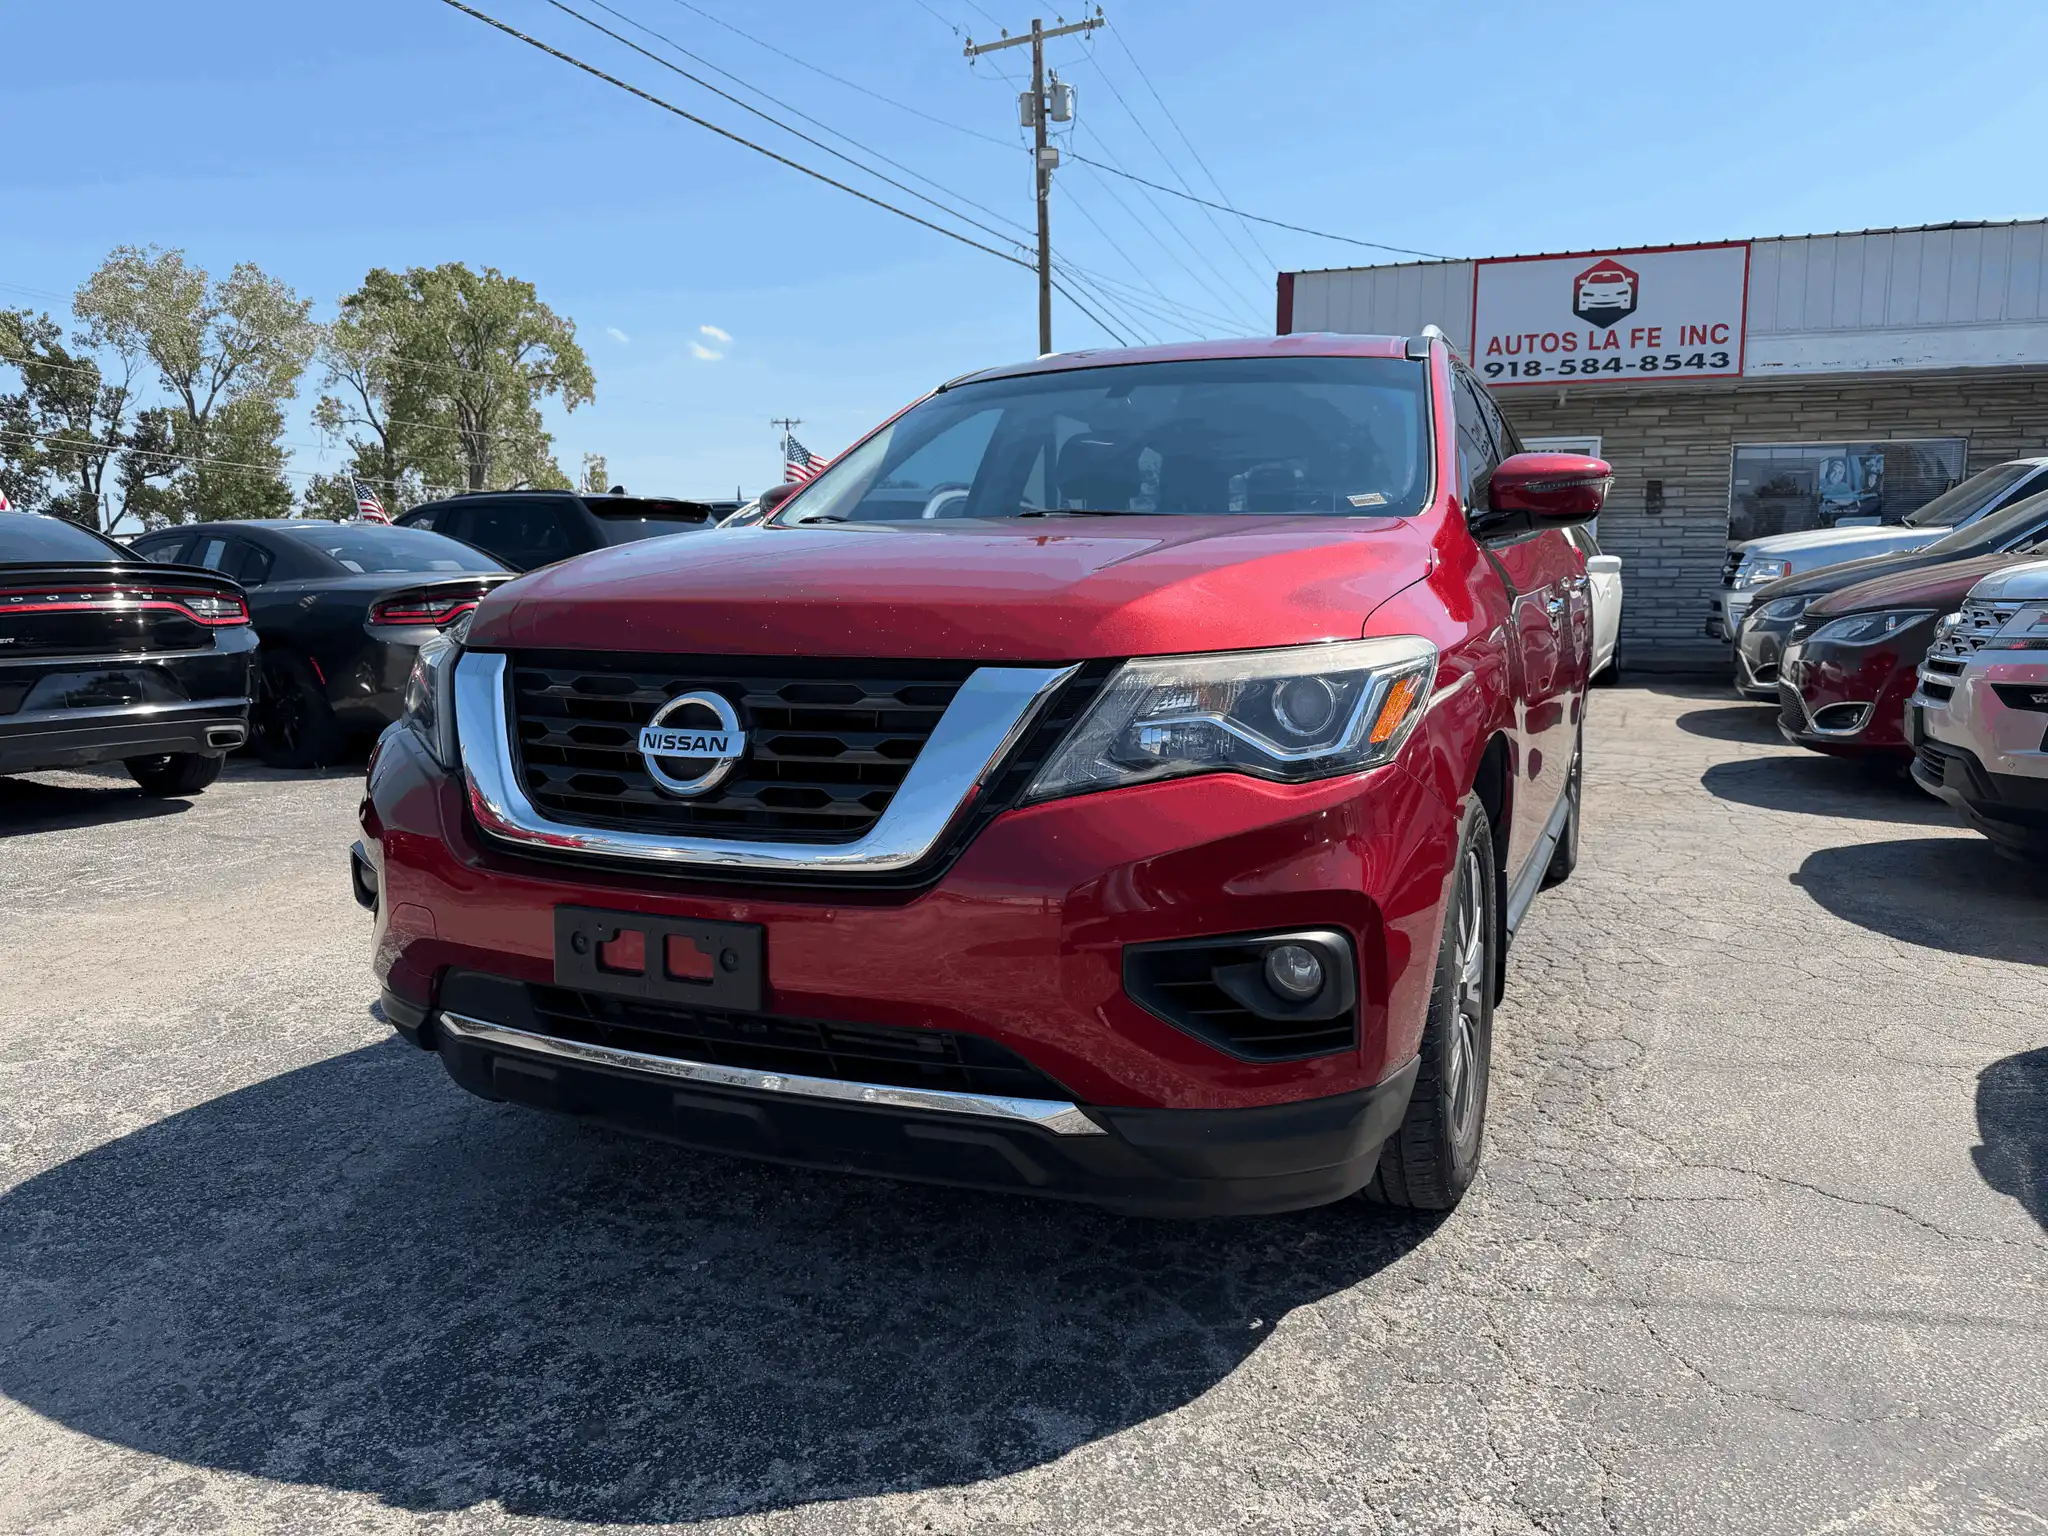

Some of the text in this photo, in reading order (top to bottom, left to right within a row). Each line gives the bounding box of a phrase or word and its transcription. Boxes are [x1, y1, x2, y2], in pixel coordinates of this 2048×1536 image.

[1486, 323, 1730, 356] AUTOS LA FE INC
[1483, 352, 1731, 378] 918-584-8543
[643, 733, 728, 752] NISSAN
